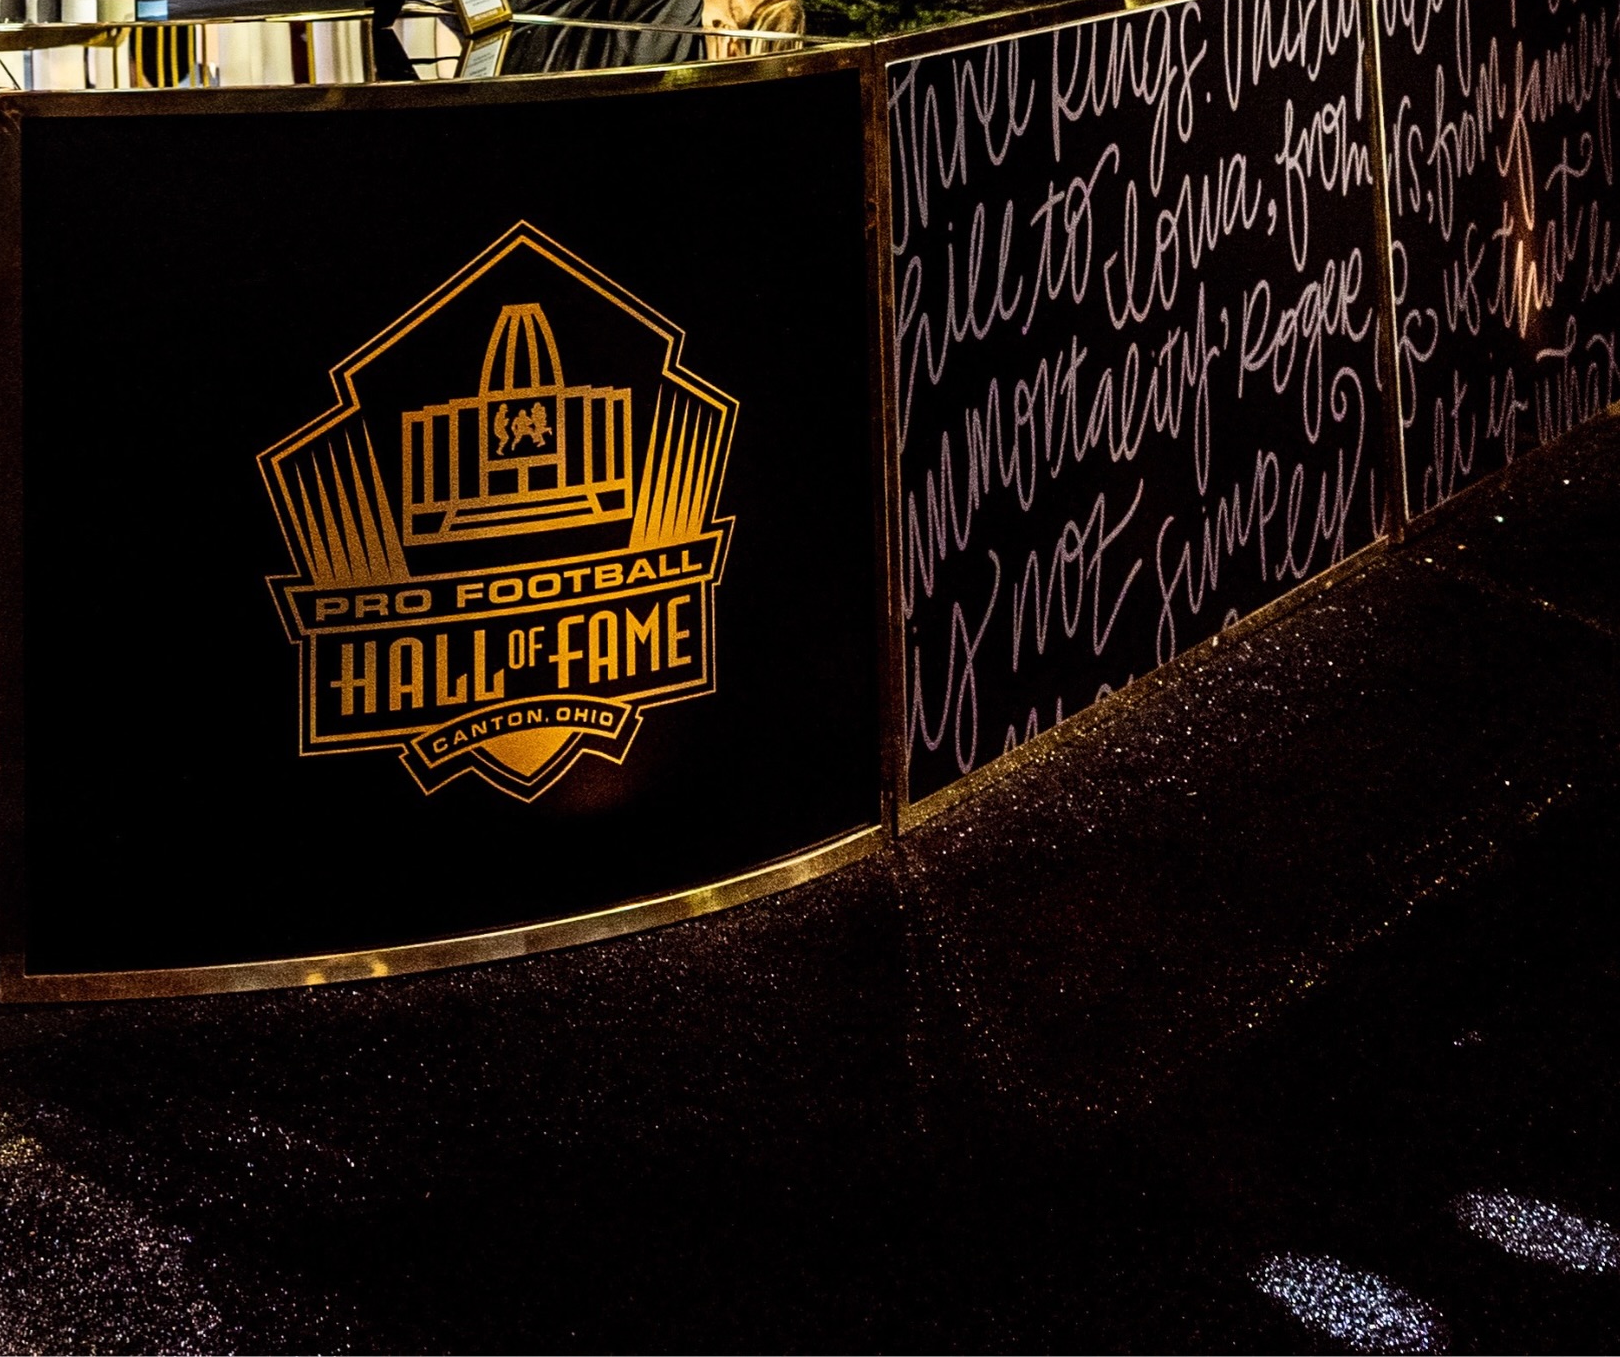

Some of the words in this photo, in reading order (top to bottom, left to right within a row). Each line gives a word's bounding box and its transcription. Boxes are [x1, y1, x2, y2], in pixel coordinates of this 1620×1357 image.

[315, 588, 433, 622] PRO
[456, 549, 703, 609] FOOTBALL
[329, 629, 506, 717] HALL
[507, 625, 546, 671] OF
[548, 593, 693, 690] FAME
[431, 707, 550, 755] CANTON,
[555, 706, 616, 729] OHIO
